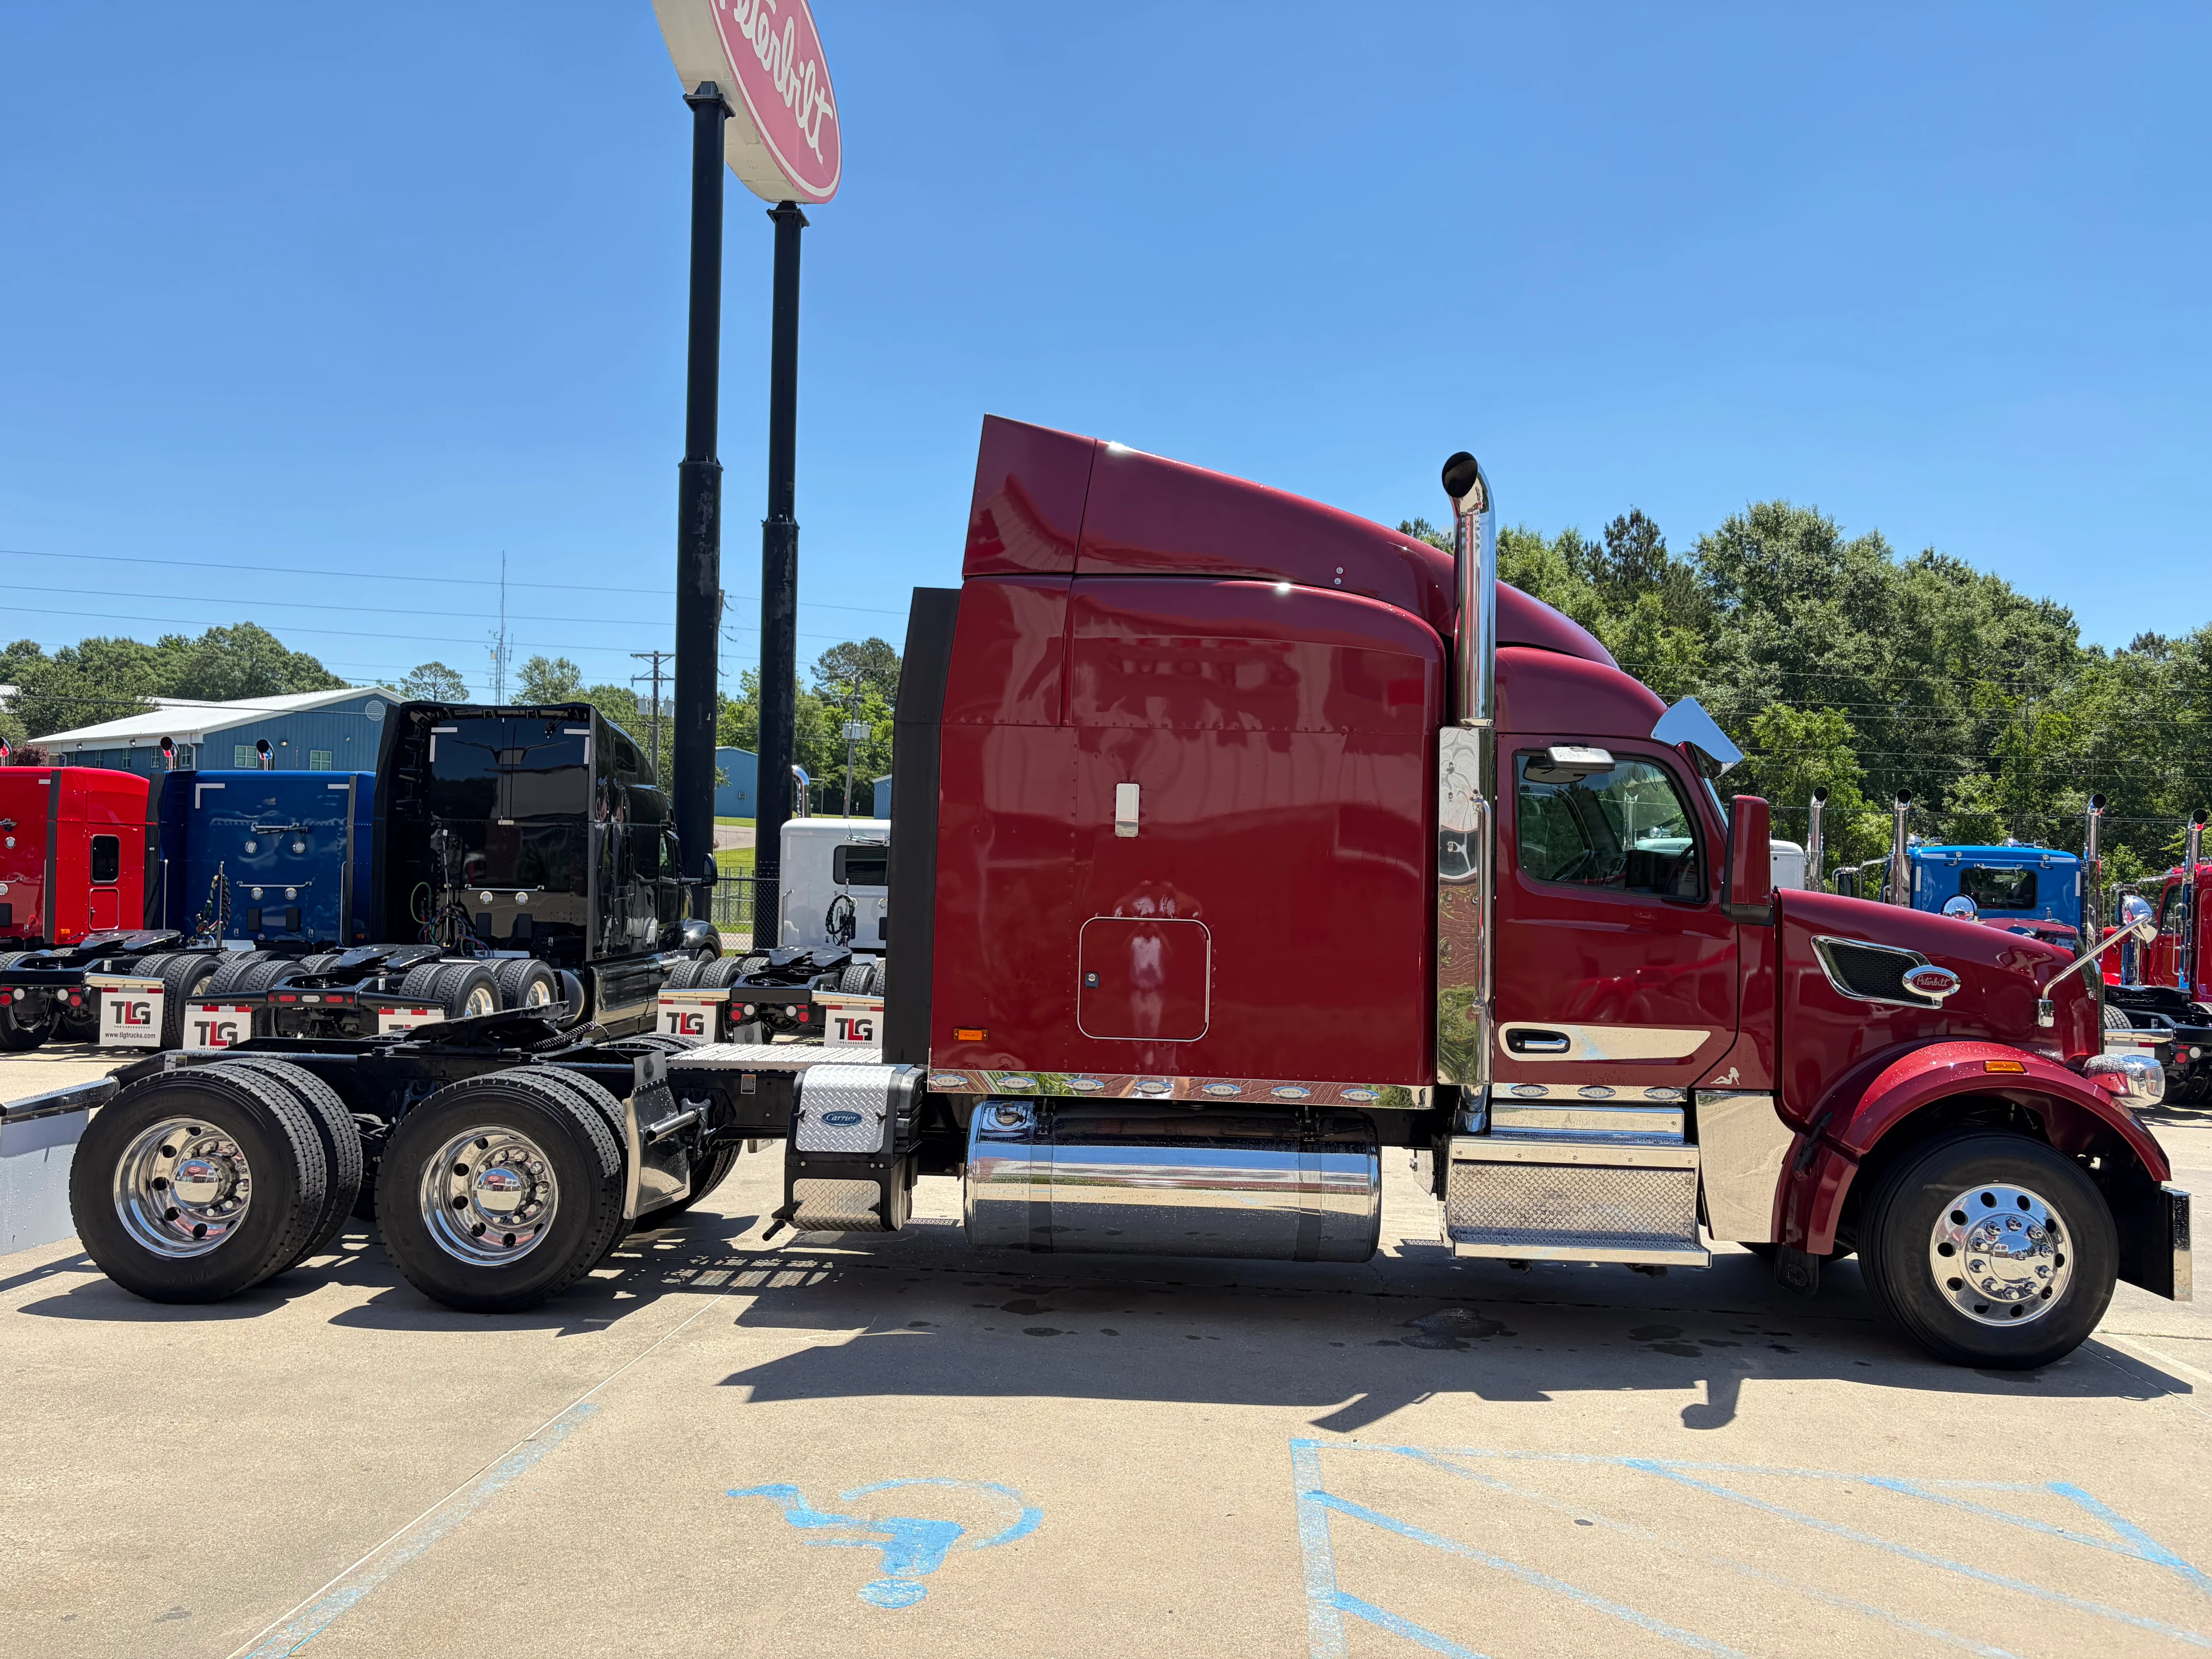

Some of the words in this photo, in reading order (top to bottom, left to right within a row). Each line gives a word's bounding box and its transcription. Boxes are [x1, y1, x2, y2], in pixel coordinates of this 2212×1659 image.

[720, 0, 833, 164] eterbilt
[1917, 975, 1951, 987] Peterbilt
[110, 1001, 151, 1024] TLG
[666, 1012, 704, 1035] TLG
[194, 1021, 238, 1046] TLG
[835, 1017, 873, 1041] TLG
